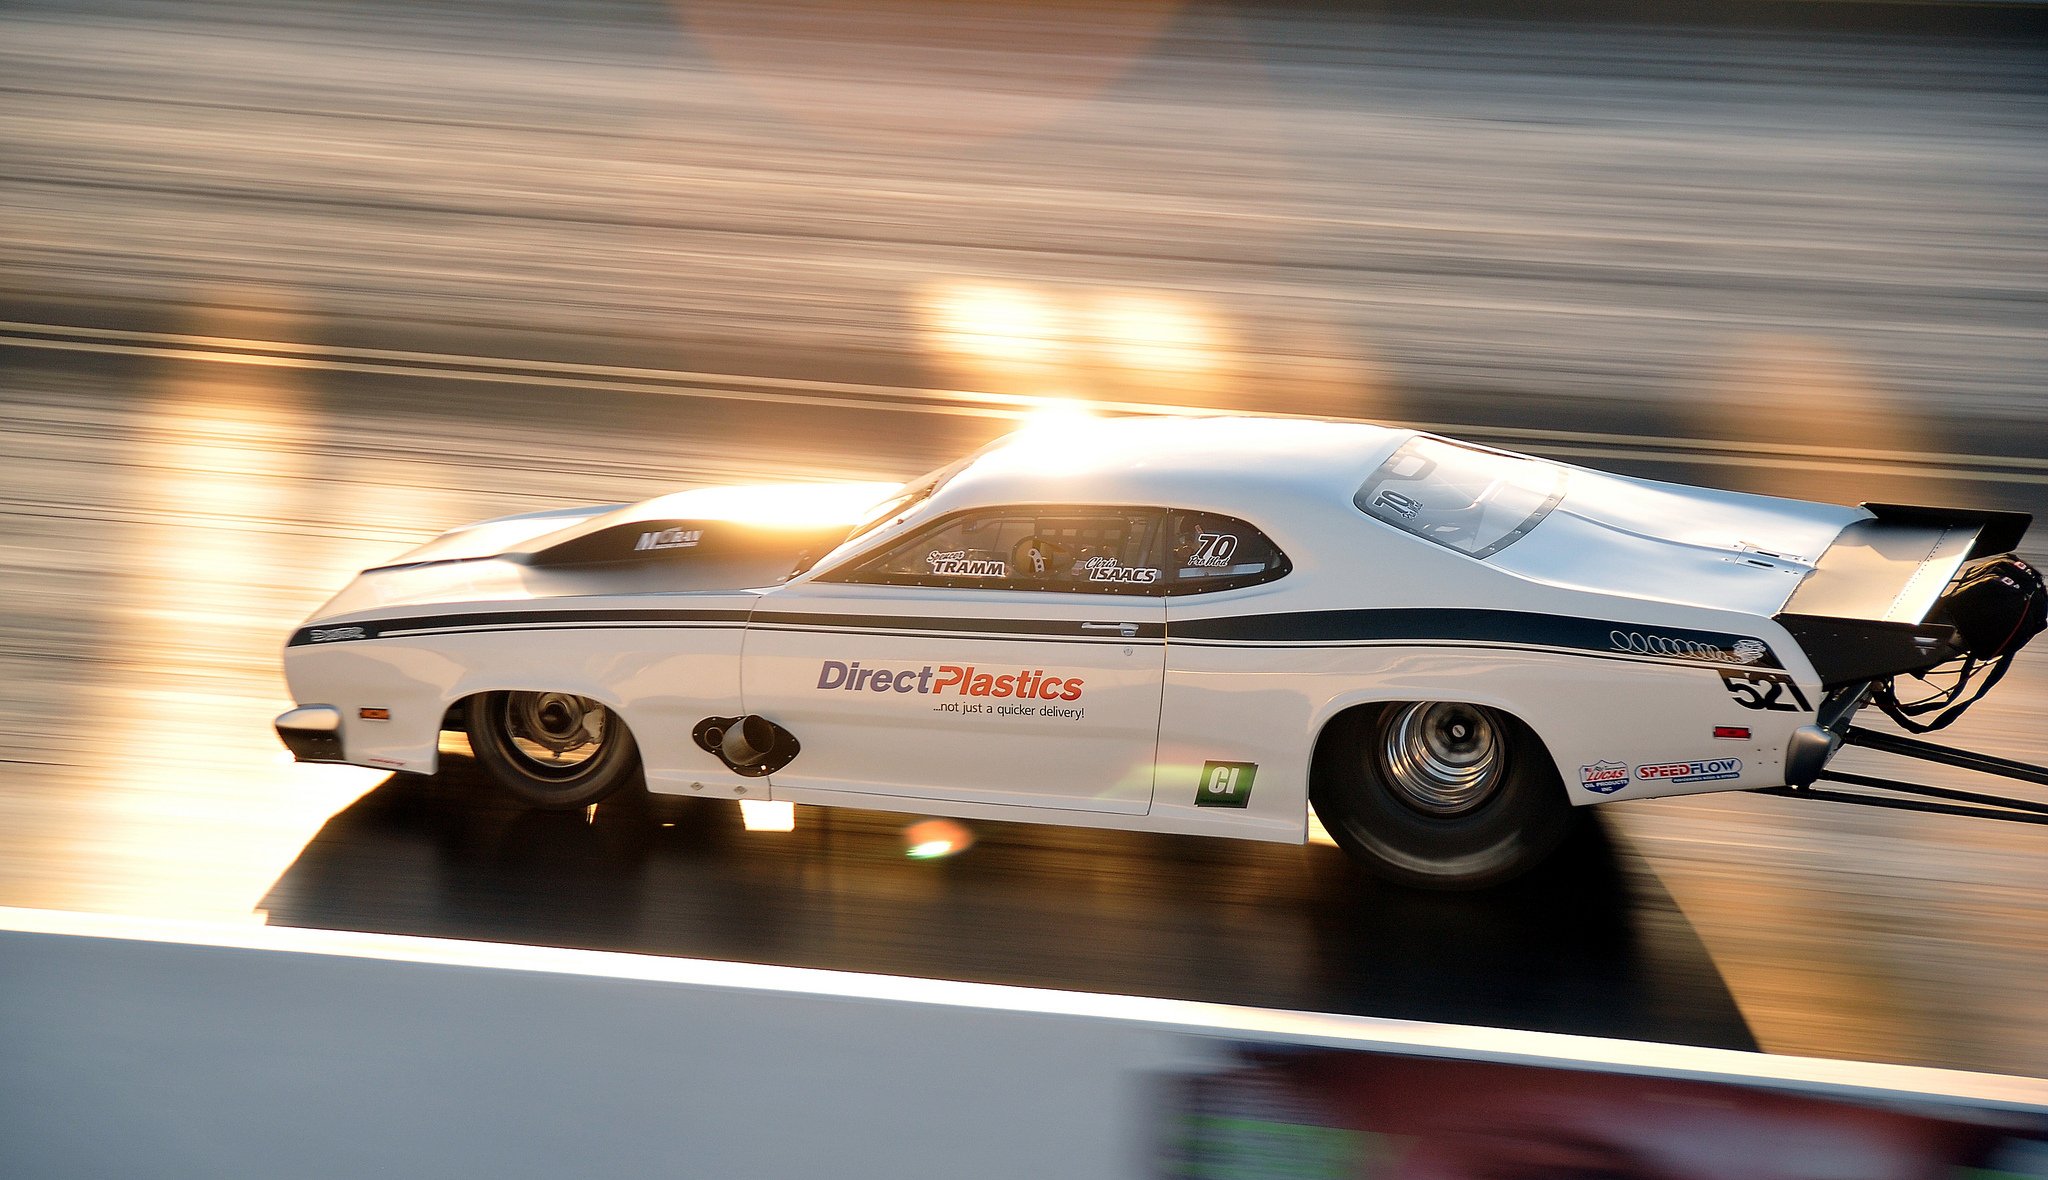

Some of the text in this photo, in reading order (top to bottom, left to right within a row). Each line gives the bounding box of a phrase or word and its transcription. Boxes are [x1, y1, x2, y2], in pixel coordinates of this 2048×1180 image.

[1373, 489, 1414, 514] 70
[1199, 534, 1238, 560] 70
[934, 560, 1006, 577] TRAMM
[1085, 557, 1117, 569] Chris
[1089, 567, 1157, 584] ISAACS
[1718, 669, 1814, 712] 521
[962, 702, 983, 715] just
[986, 705, 993, 714] a
[997, 704, 1036, 717] quicker
[1039, 706, 1085, 721] delivery!
[1586, 769, 1625, 781] LUCAS
[1640, 760, 1735, 778] SPEEDFLOW
[1208, 766, 1240, 794] CI
